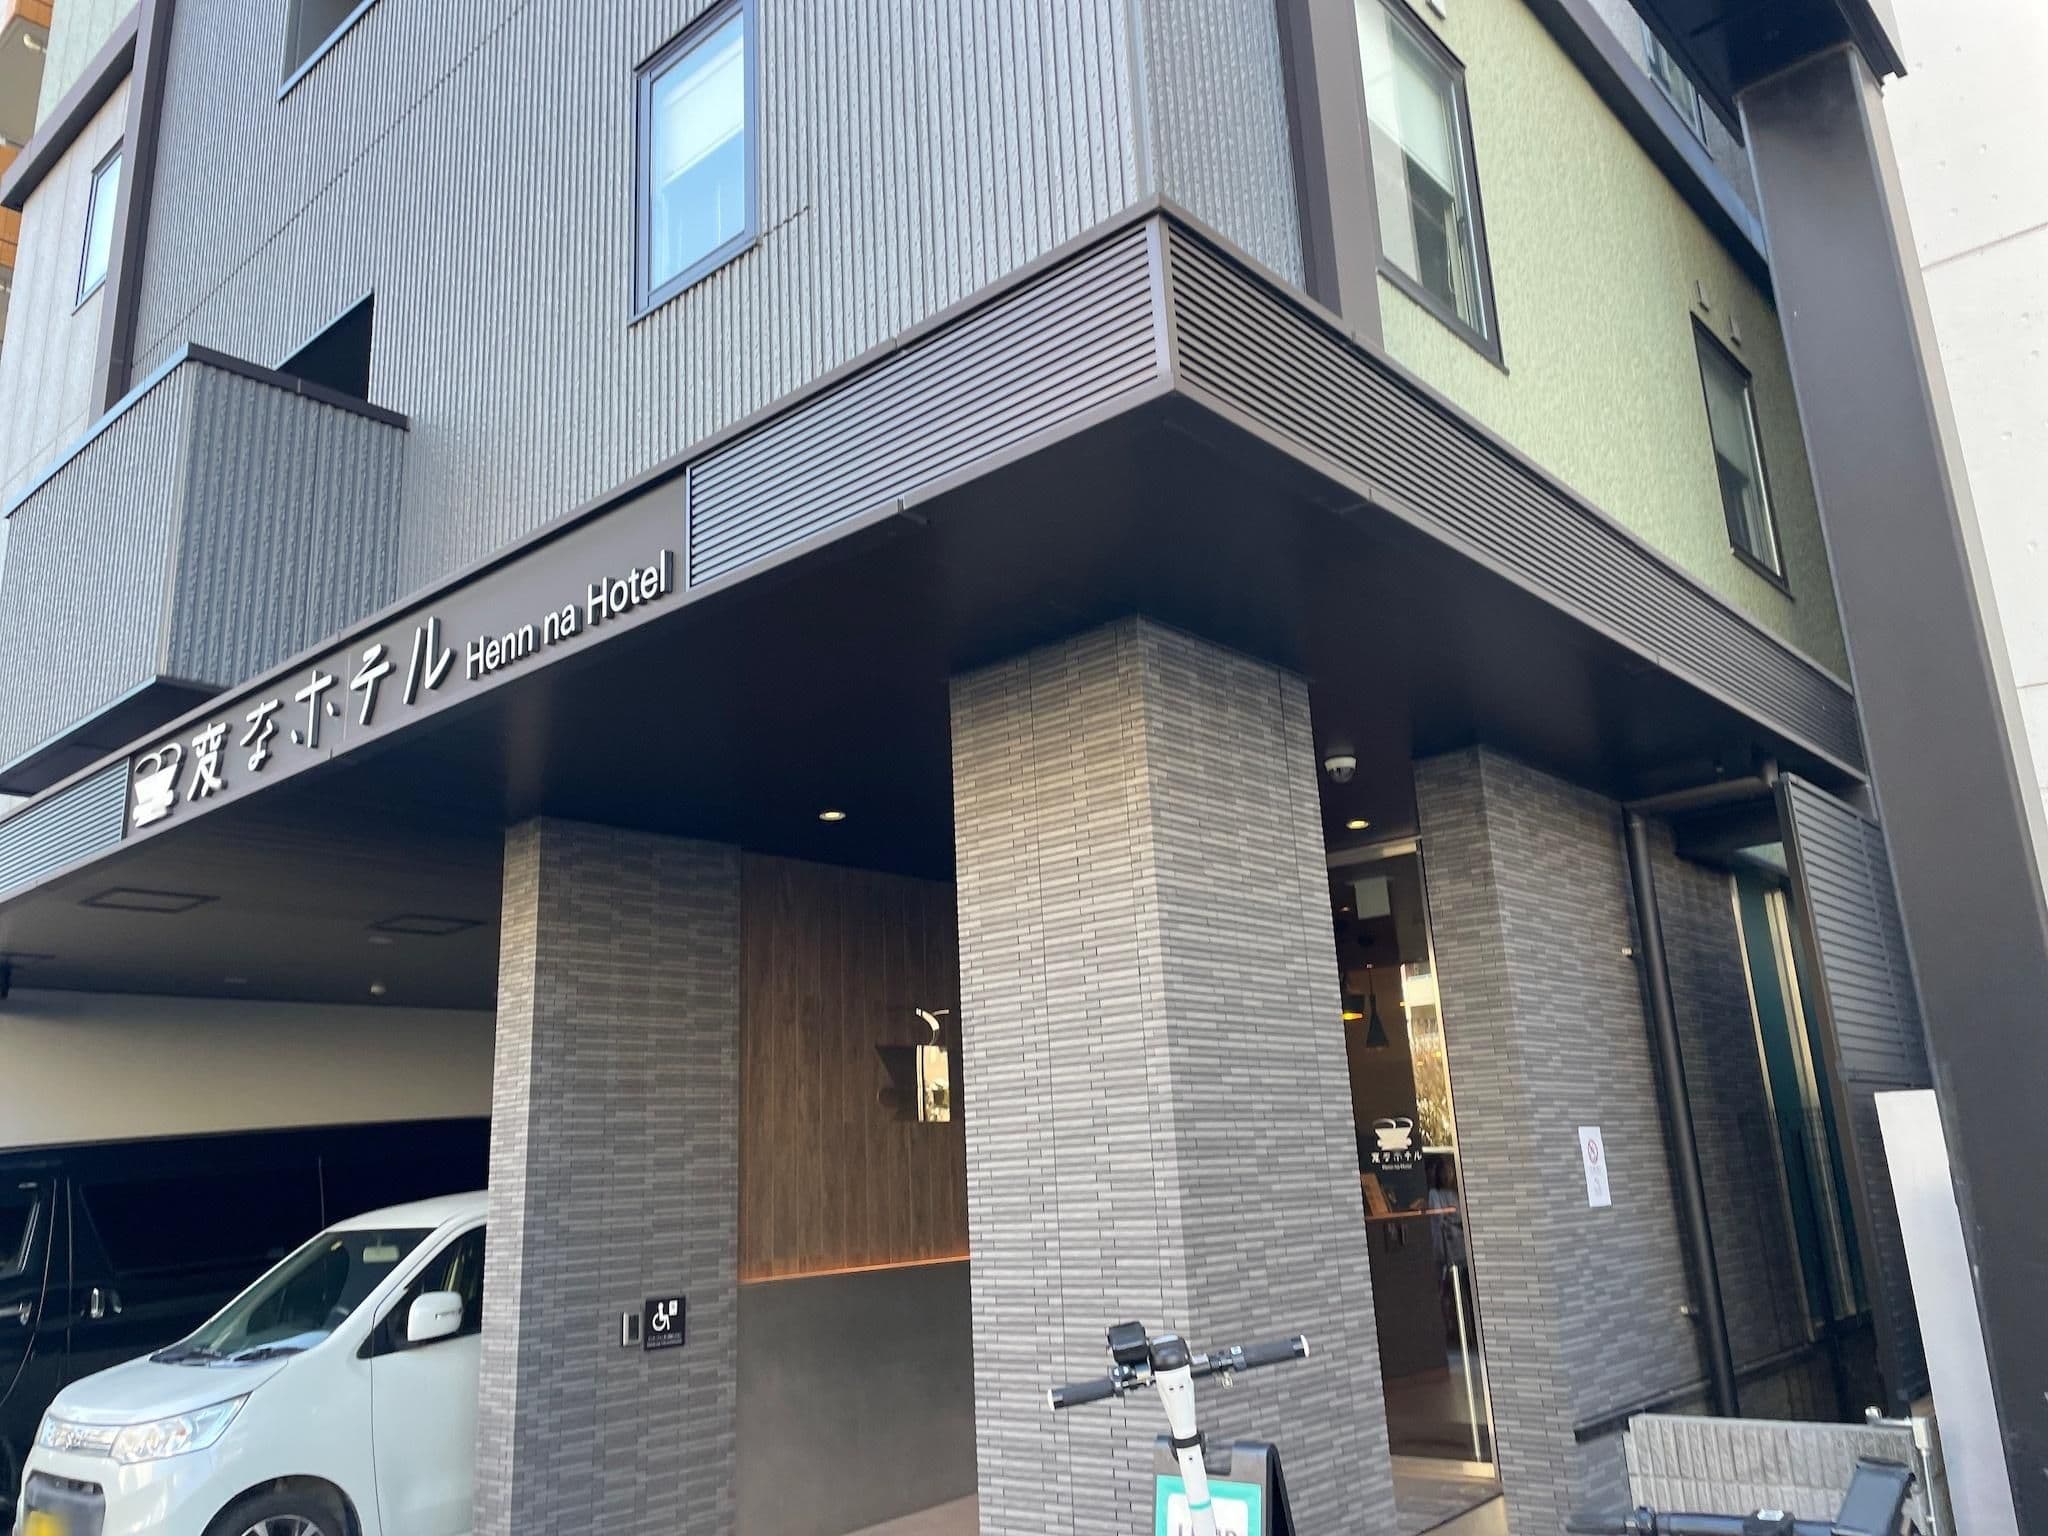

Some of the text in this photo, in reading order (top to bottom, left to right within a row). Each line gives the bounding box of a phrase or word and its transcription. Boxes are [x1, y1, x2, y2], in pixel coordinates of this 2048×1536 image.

[465, 548, 671, 681] Henn na Hotel
[187, 615, 454, 802] 変なホテル
